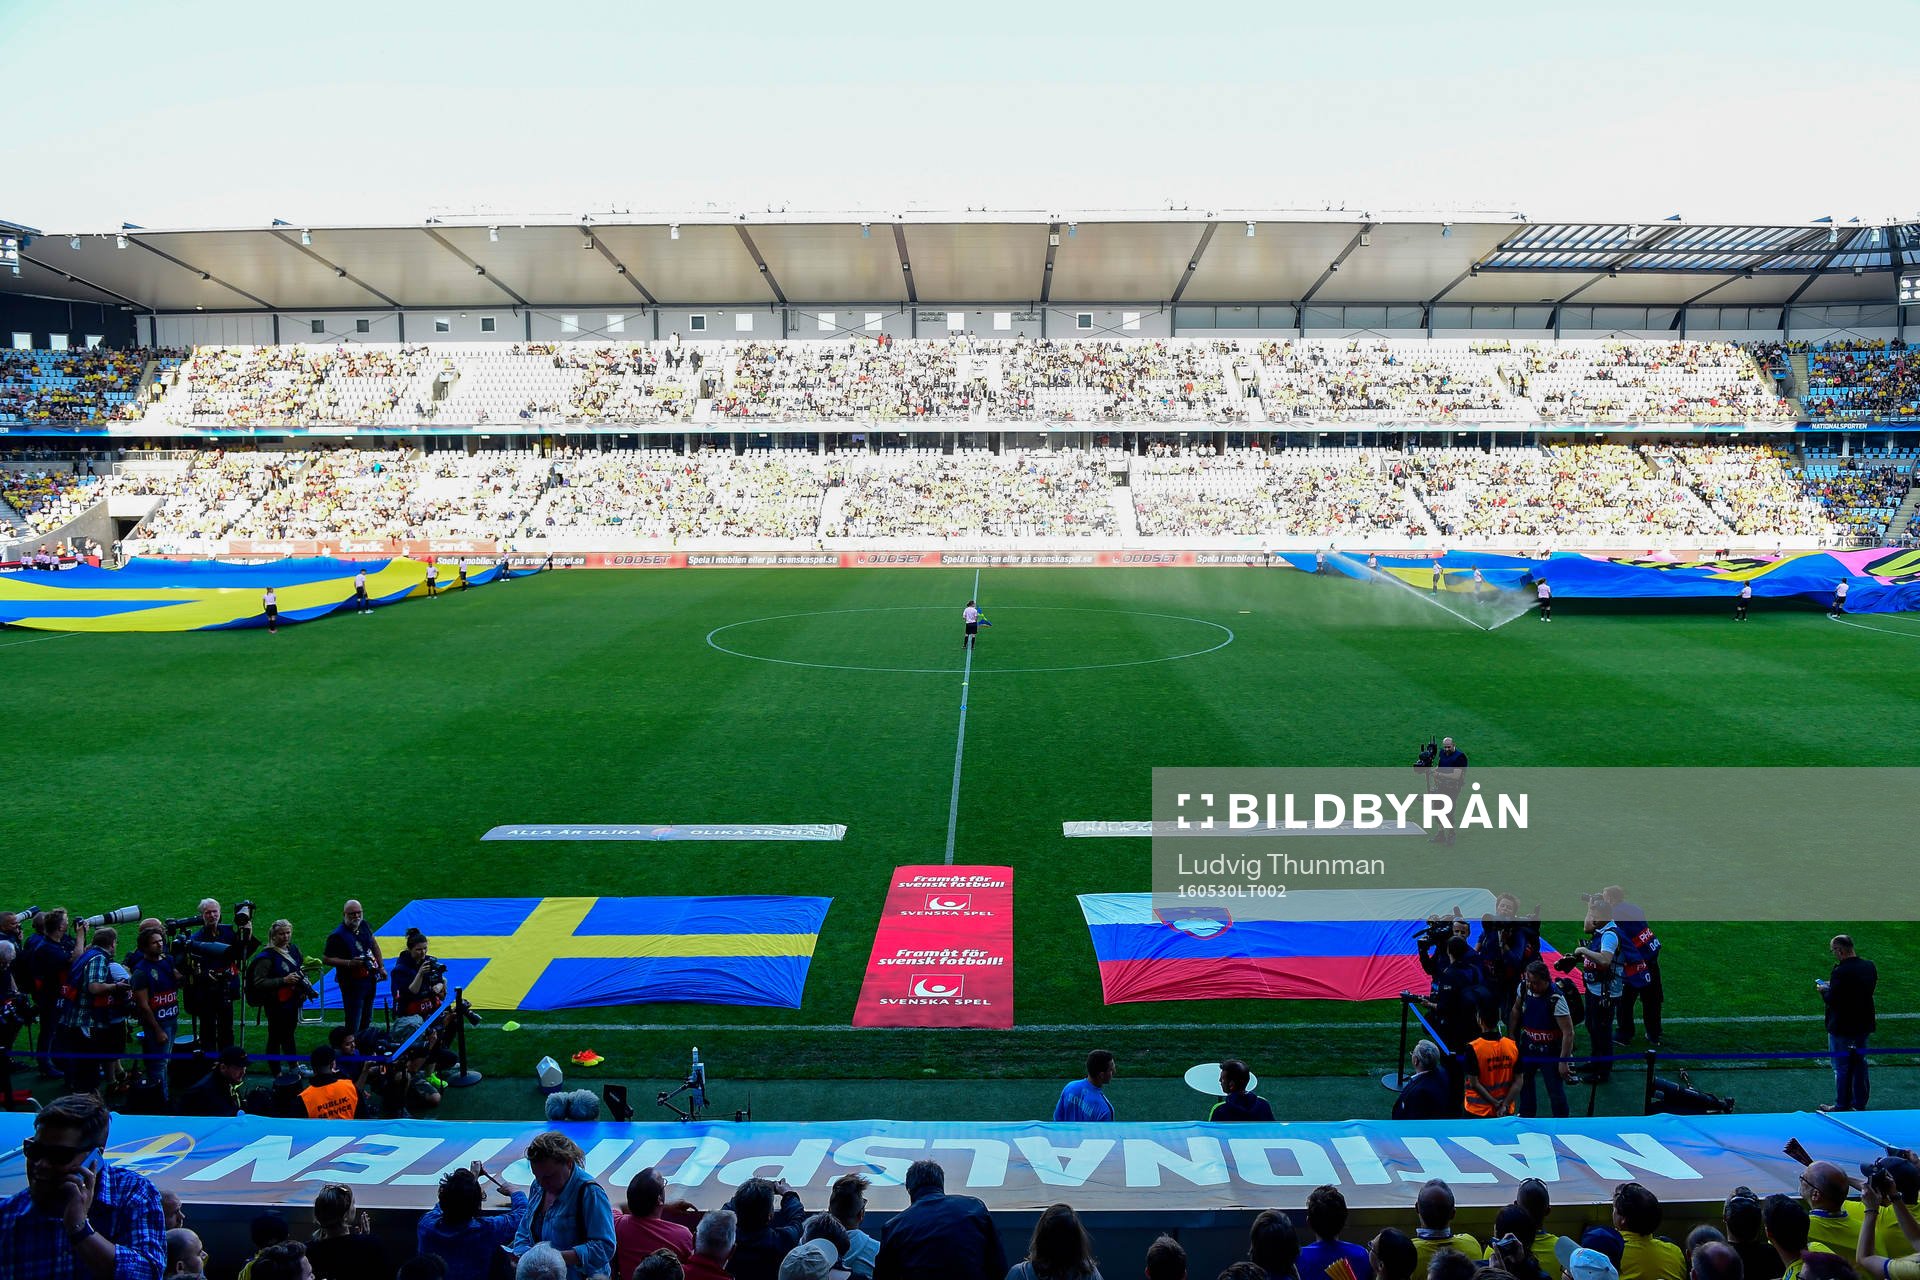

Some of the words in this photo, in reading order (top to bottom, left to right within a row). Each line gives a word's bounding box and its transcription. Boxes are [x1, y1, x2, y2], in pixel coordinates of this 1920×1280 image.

[614, 555, 671, 566] ODDSET
[688, 555, 711, 566] Spela
[715, 555, 747, 564] mobilen
[748, 555, 766, 564] eller
[766, 554, 777, 566] på
[778, 555, 838, 566] svenskaspel.se
[867, 554, 924, 564] ODDSET
[942, 555, 965, 565] Spela
[1002, 554, 1020, 563] eller
[1021, 554, 1032, 564] på
[1122, 553, 1180, 563] ODDSET
[1197, 554, 1220, 565] Spela
[913, 875, 967, 883] Framåt
[969, 875, 992, 883] för
[896, 949, 959, 957] Framåt
[961, 949, 989, 957] för
[878, 957, 936, 965] svensk
[939, 957, 1004, 966] fotboll!
